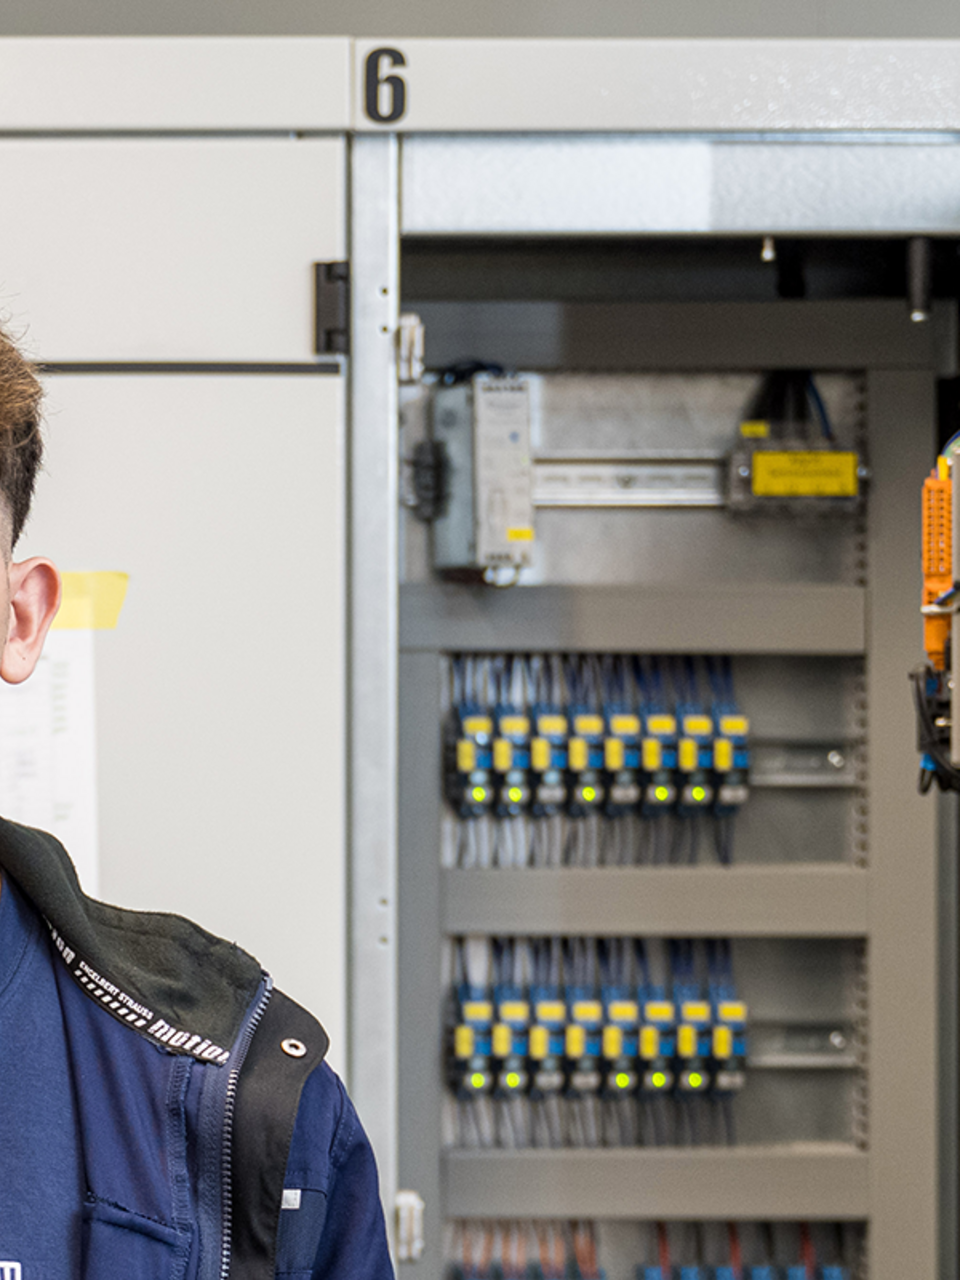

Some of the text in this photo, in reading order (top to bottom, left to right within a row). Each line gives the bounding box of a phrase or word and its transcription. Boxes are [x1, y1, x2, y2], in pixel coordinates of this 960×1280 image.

[365, 47, 406, 125] 6
[79, 960, 154, 1020] ENGELBERT STRAUSS
